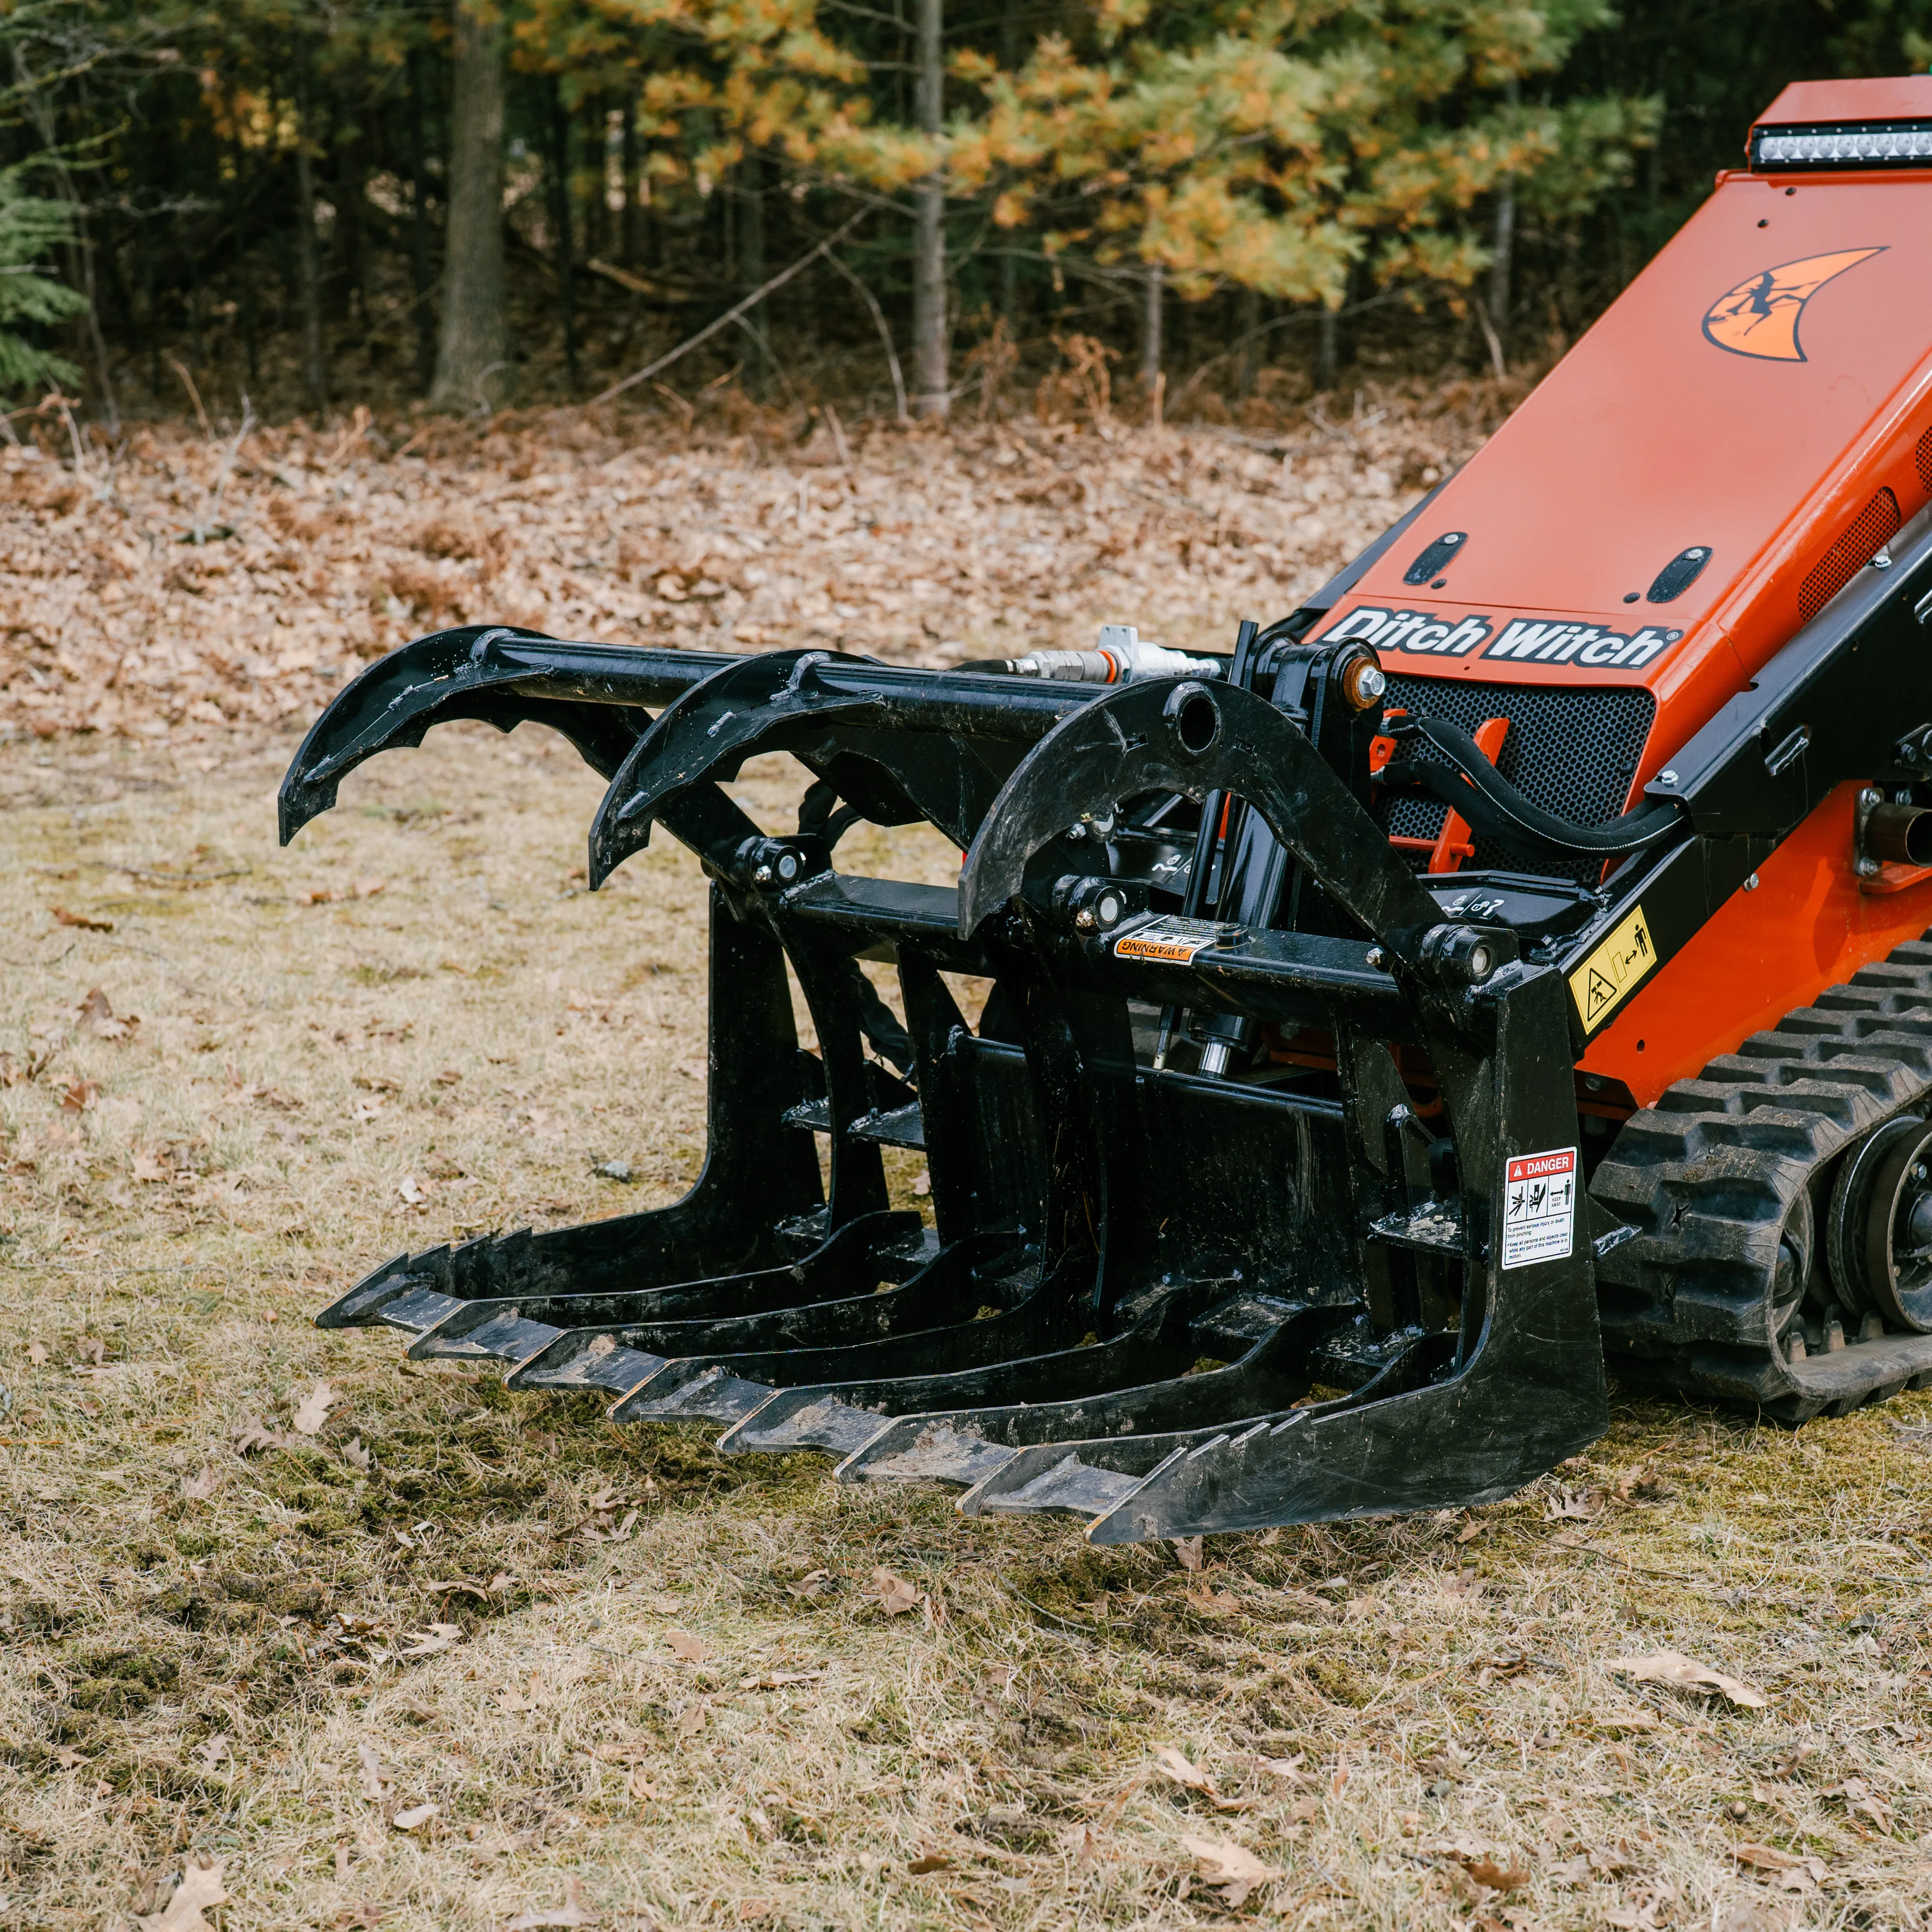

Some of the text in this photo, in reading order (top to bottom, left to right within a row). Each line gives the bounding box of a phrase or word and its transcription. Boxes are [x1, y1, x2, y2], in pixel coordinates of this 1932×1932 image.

[1322, 609, 1486, 653] Ditch
[1122, 941, 1175, 956] WARNING
[1527, 1156, 1569, 1174] DANGER
